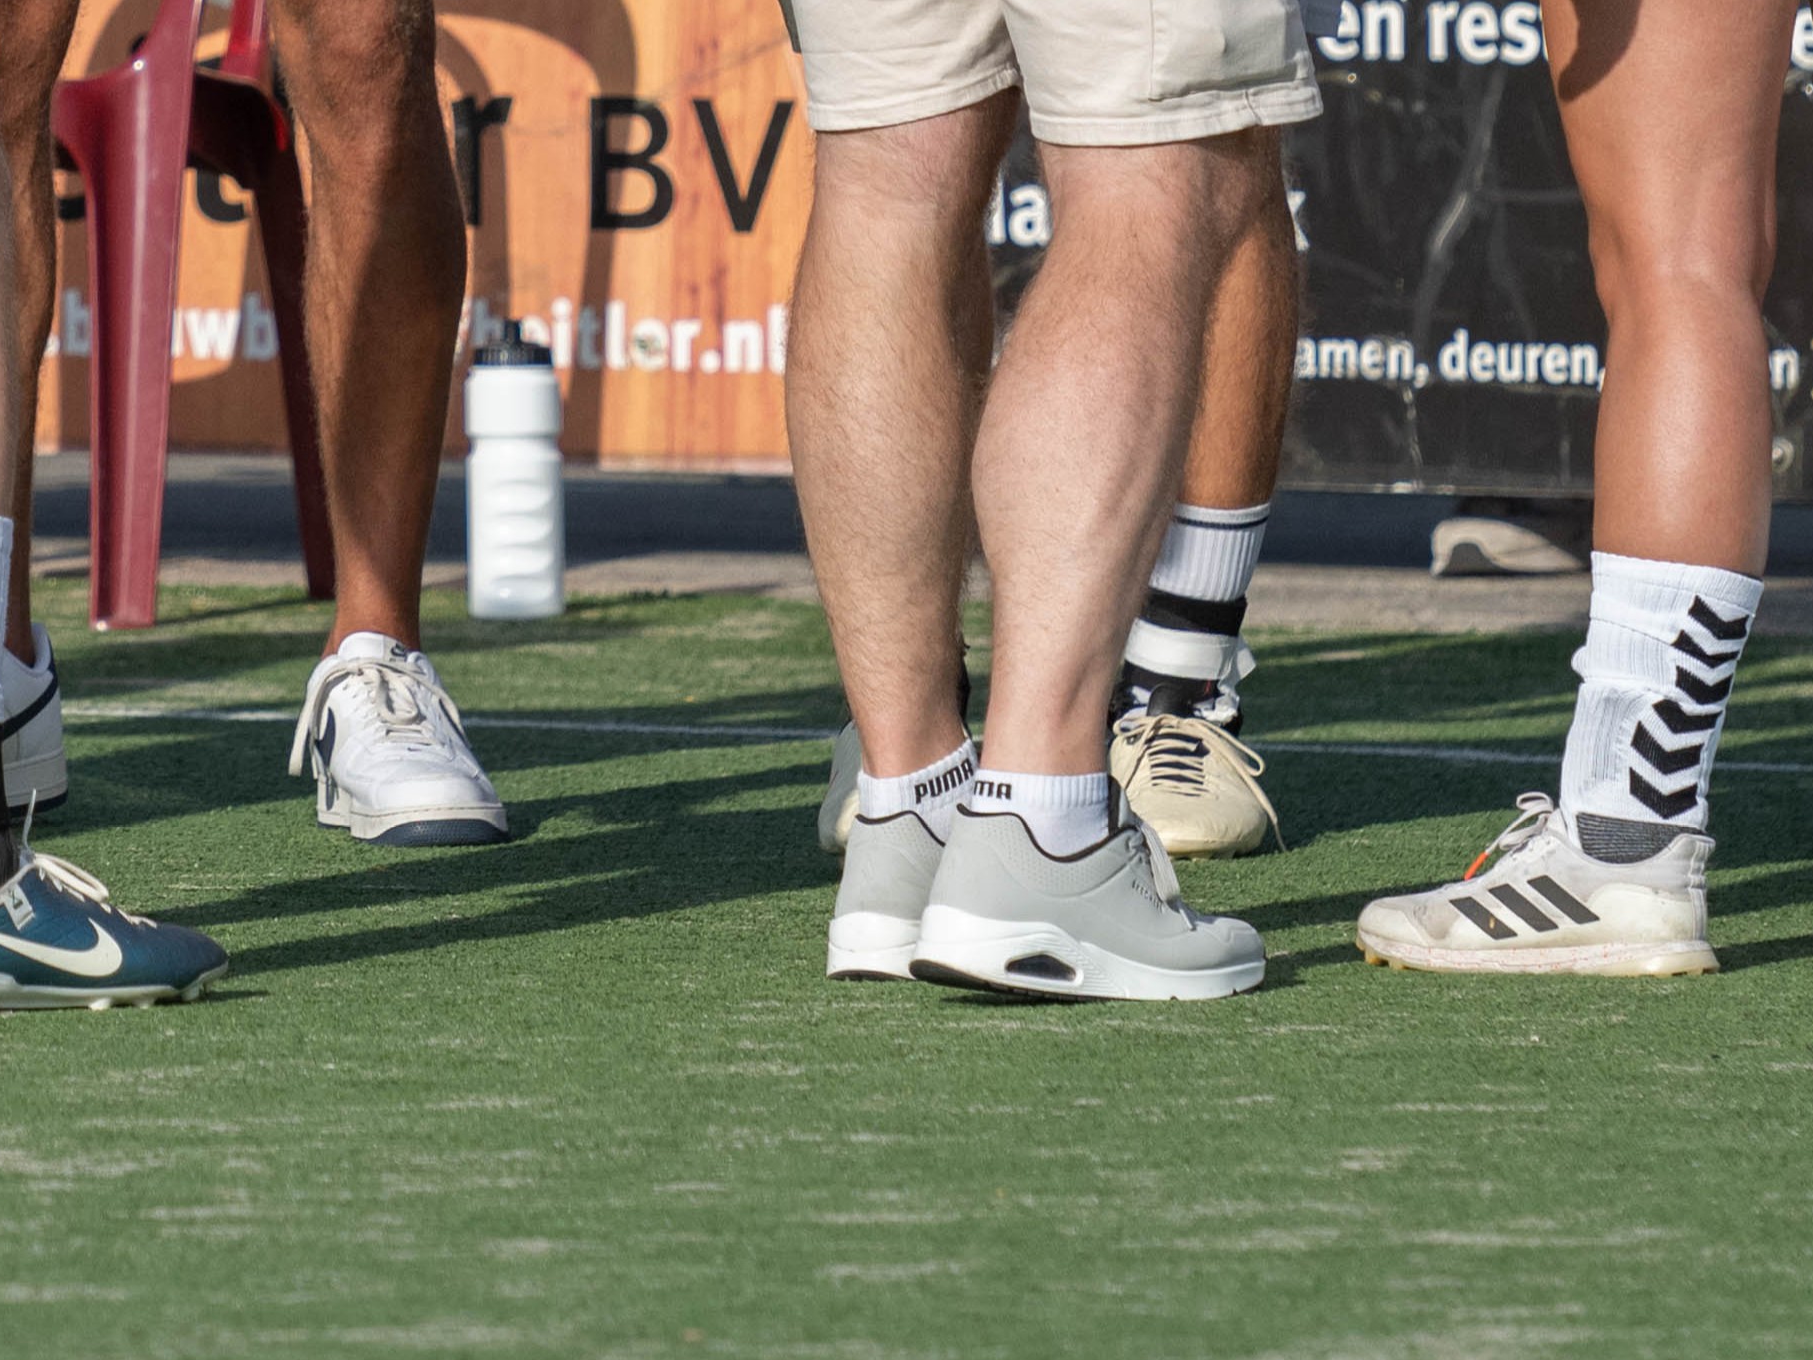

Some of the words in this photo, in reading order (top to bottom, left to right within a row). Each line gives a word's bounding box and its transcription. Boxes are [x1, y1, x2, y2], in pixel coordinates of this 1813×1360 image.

[589, 97, 795, 233] BV
[1438, 328, 1605, 392] deuren,
[914, 758, 974, 805] PUMA
